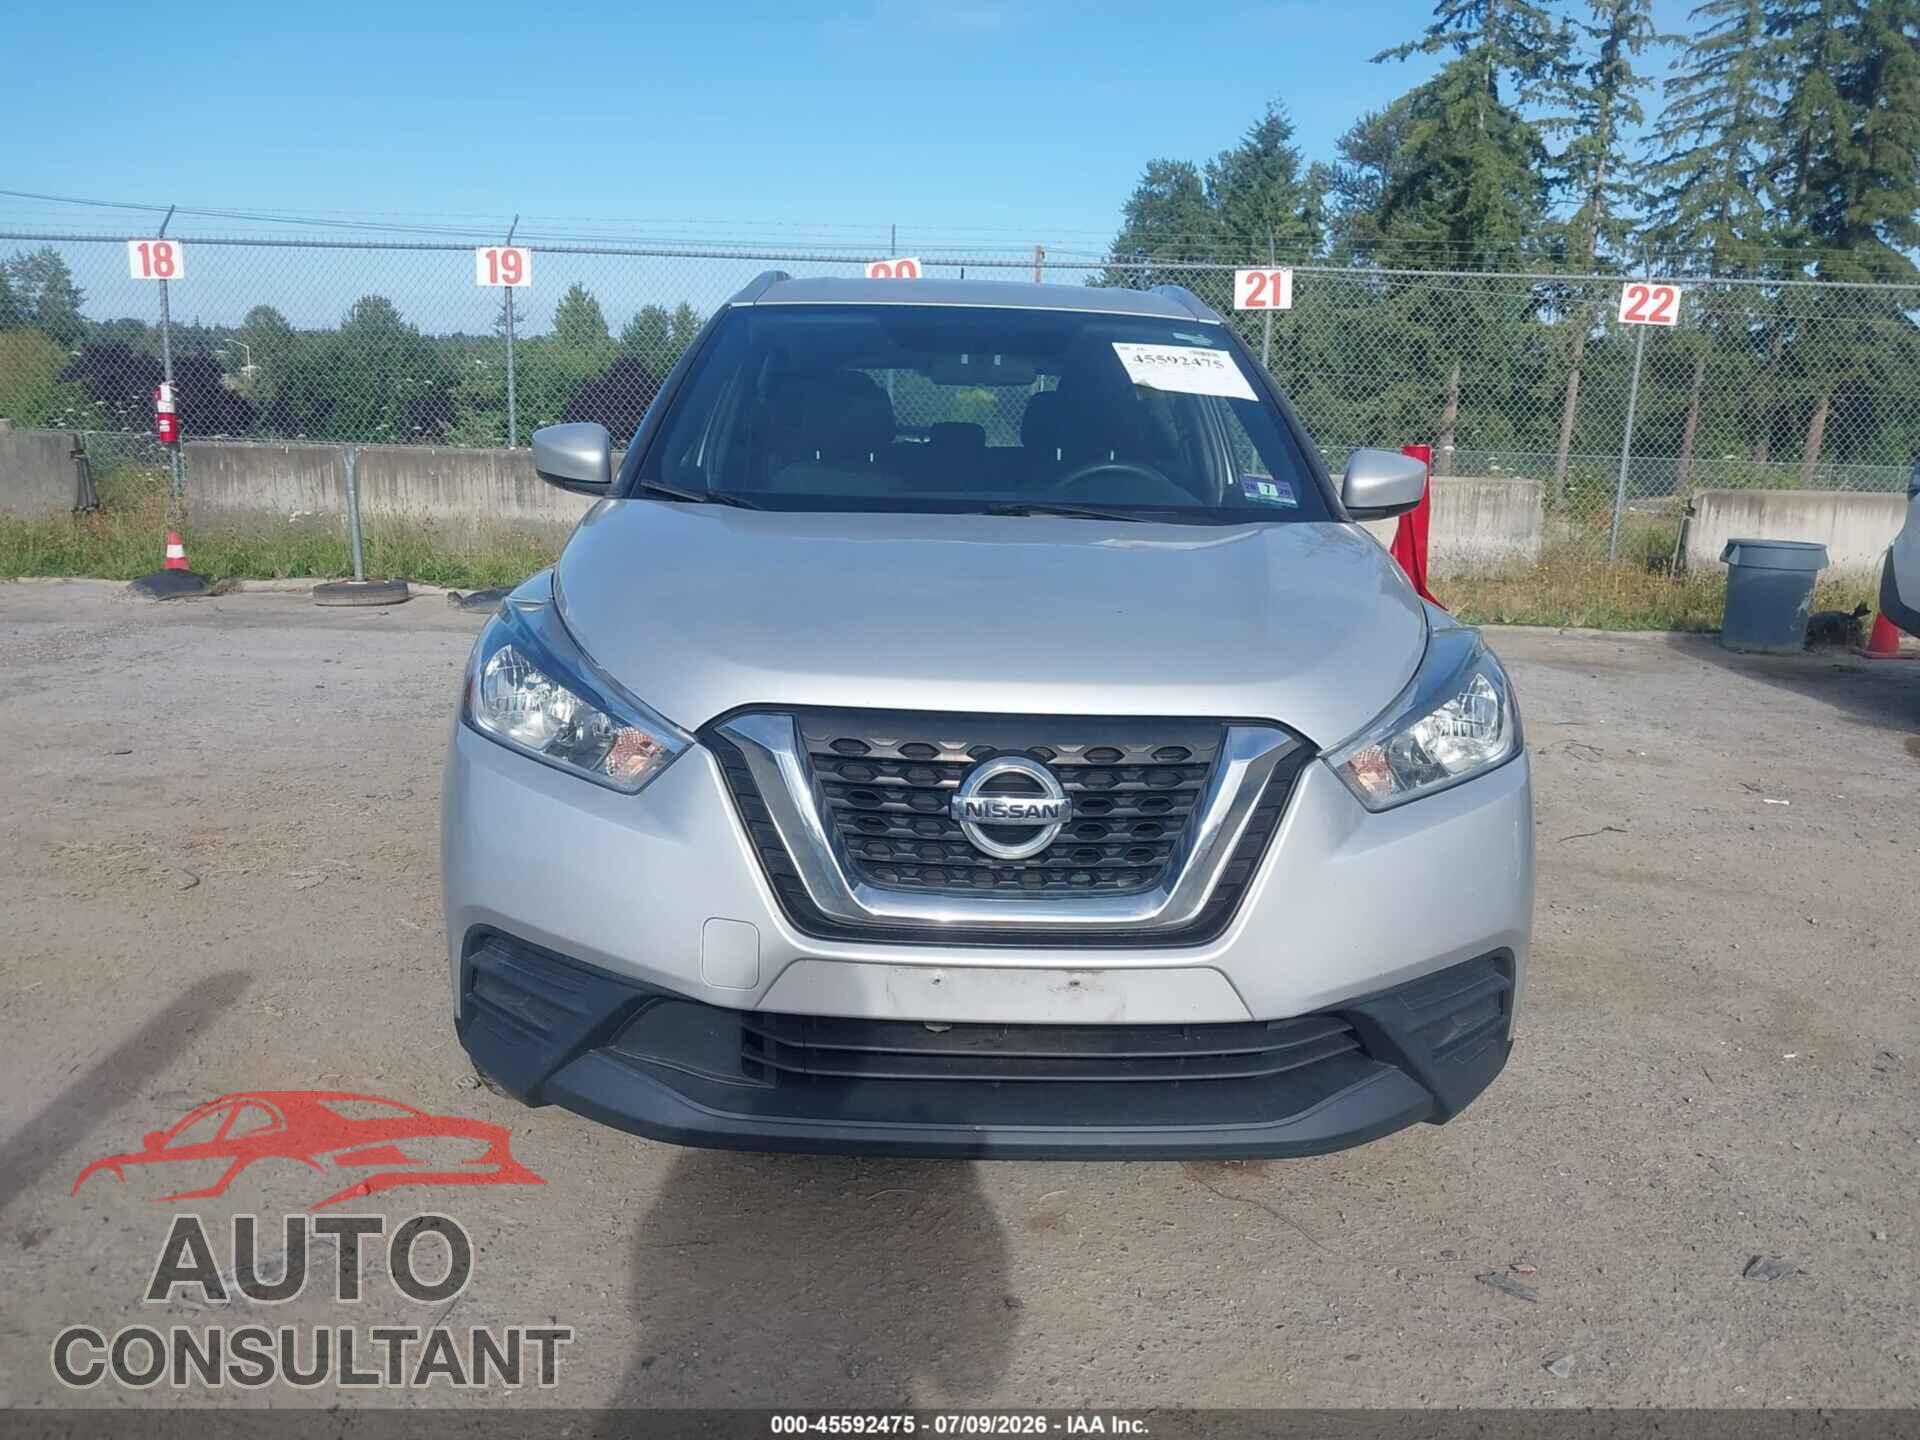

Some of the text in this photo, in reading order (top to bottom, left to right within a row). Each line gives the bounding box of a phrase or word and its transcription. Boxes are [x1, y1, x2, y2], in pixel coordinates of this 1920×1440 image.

[137, 242, 175, 277] 18
[485, 249, 522, 285] 19
[1246, 271, 1281, 307] 21
[1624, 285, 1674, 322] 22
[1134, 354, 1225, 369] 45592475
[965, 801, 1060, 818] NISSAN
